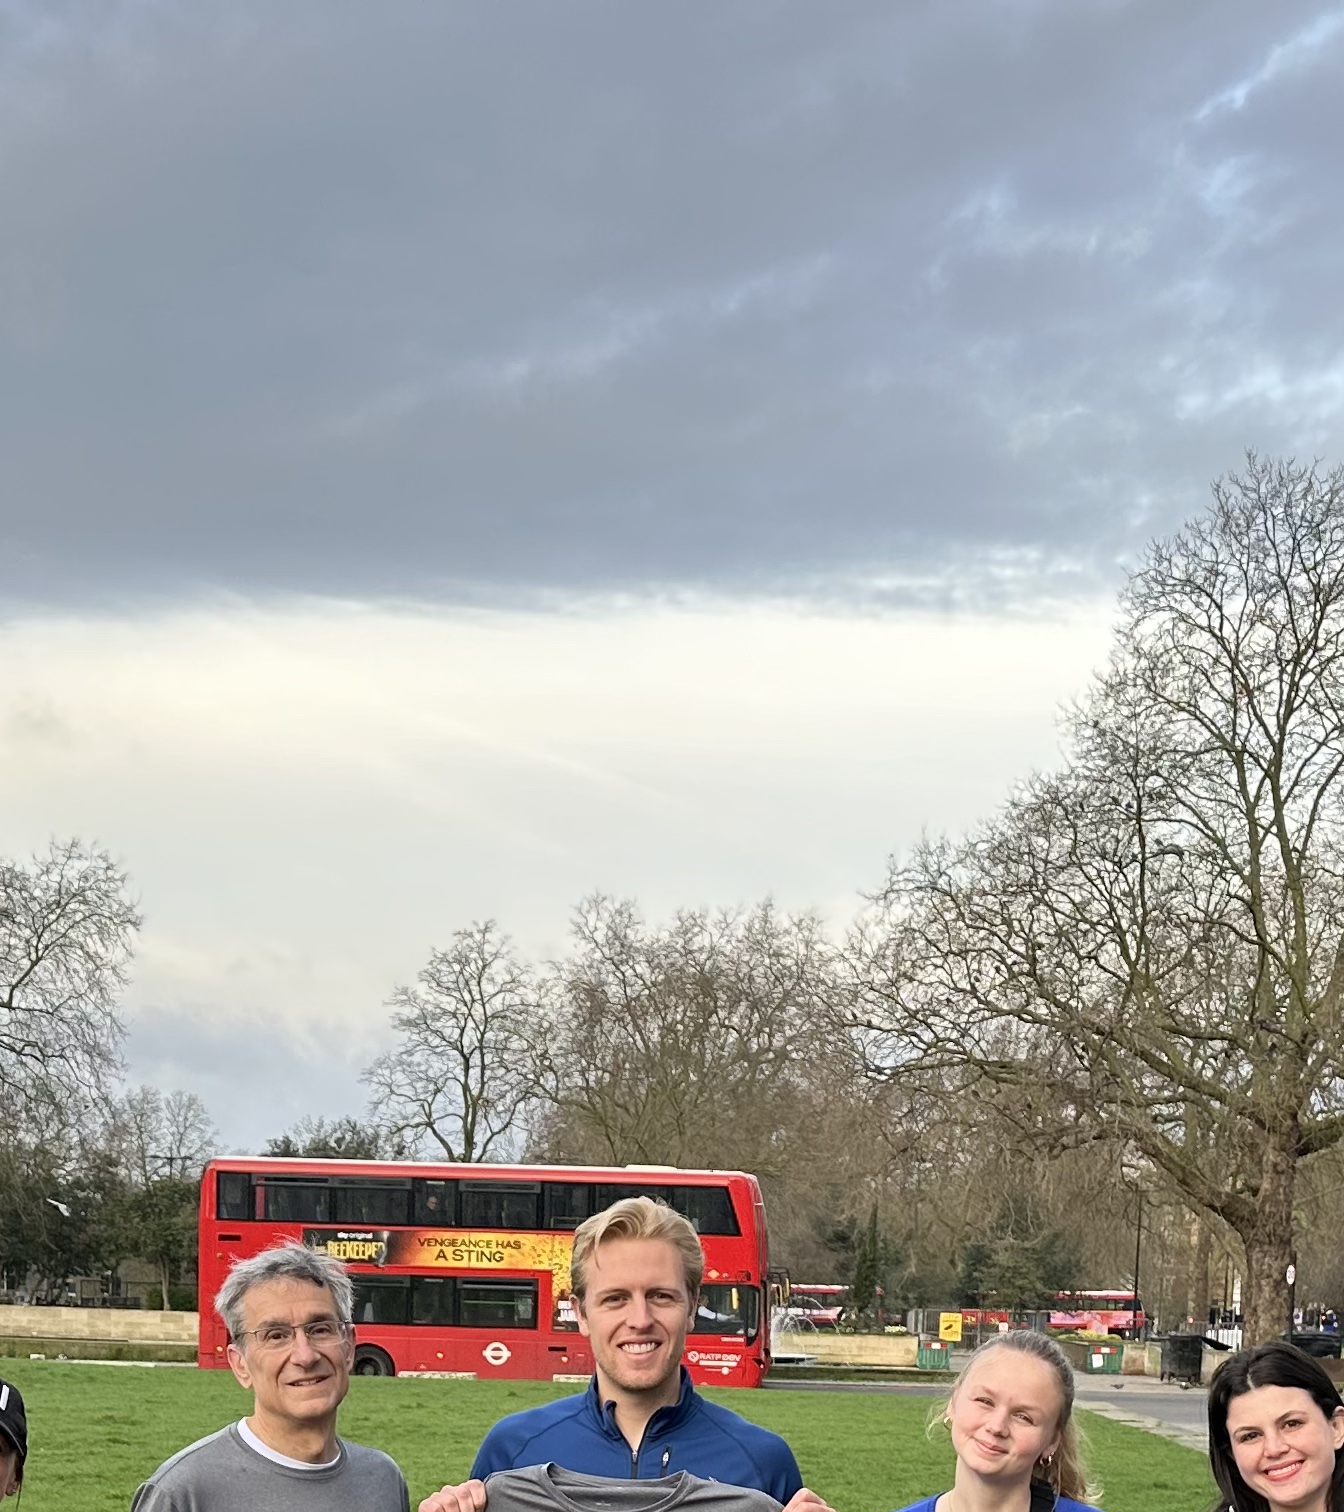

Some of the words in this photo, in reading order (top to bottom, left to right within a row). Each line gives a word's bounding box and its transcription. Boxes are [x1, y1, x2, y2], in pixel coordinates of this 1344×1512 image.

[417, 1237, 492, 1249] VENGEANCE
[495, 1240, 522, 1250] HAS
[434, 1249, 449, 1261] A
[451, 1250, 505, 1263] STING
[699, 1353, 721, 1361] RATP
